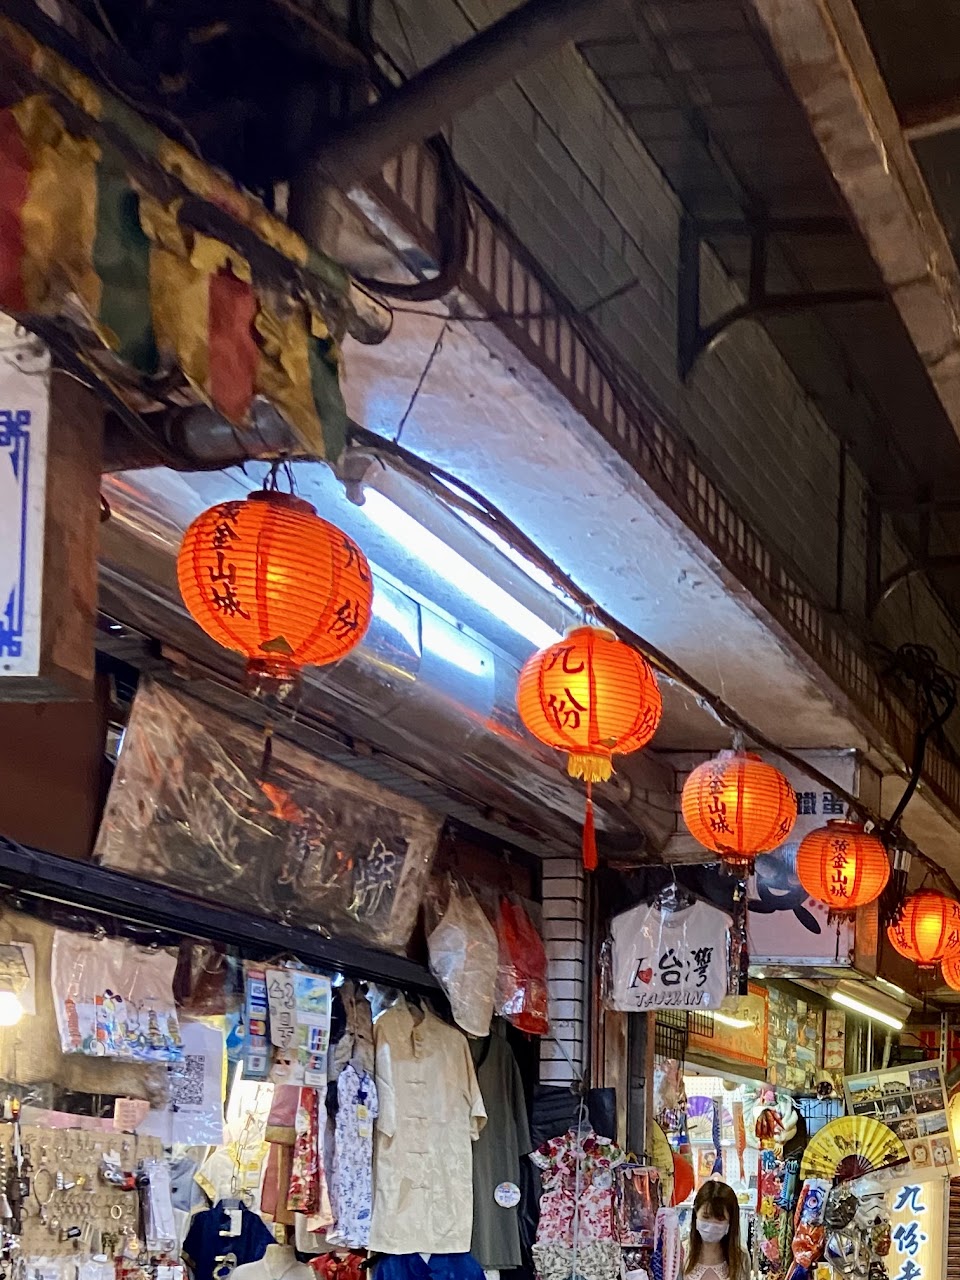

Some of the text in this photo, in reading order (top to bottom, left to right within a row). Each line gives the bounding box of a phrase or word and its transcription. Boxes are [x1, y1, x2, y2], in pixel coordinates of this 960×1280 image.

[544, 645, 588, 730] 九份
[830, 839, 851, 899] 黃金山城
[659, 947, 714, 988] 台灣
